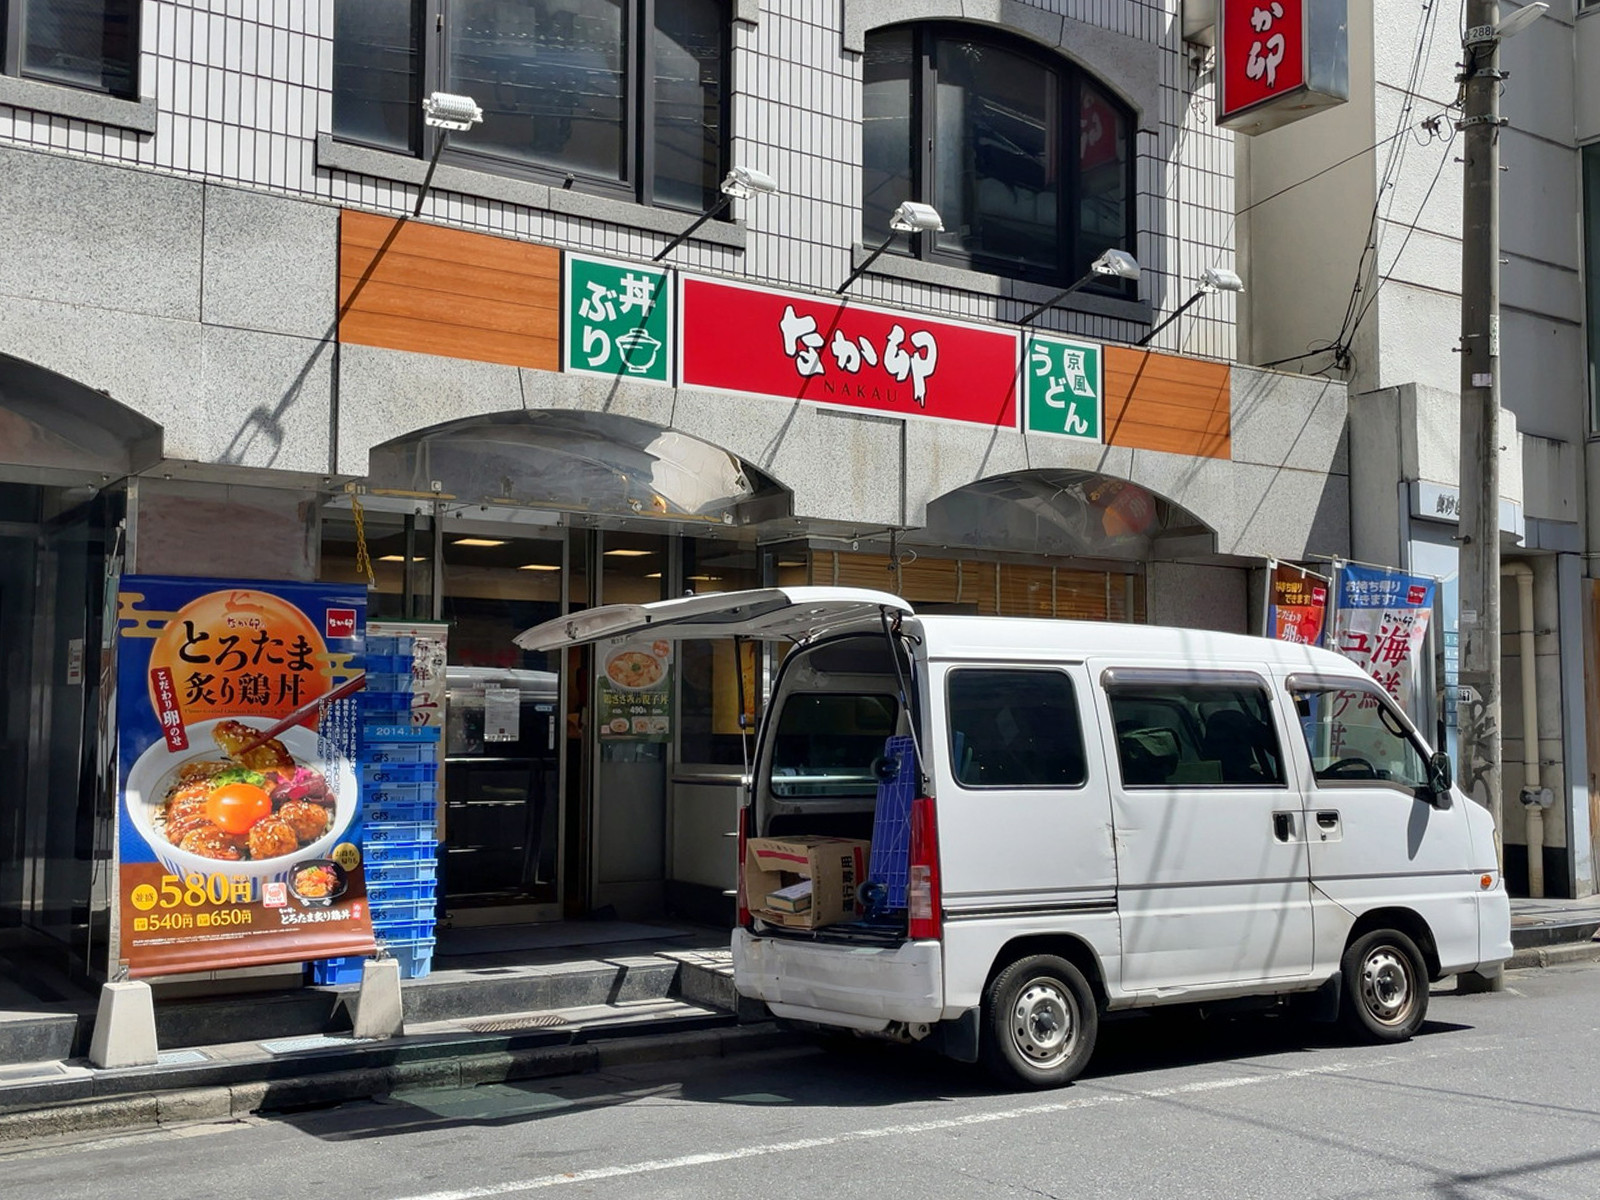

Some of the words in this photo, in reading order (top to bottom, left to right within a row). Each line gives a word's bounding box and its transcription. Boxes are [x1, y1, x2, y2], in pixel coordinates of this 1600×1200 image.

[618, 272, 657, 318] 丼
[779, 304, 938, 408] なか卯
[1067, 353, 1087, 393] 京風
[823, 380, 898, 403] NAKAU
[1031, 343, 1089, 434] うどん
[1345, 580, 1401, 594] お持ち帰り
[329, 618, 354, 629] なか卯
[179, 619, 314, 672] とろたま
[183, 671, 306, 707] 炙り鶏丼
[157, 671, 182, 746] こだわり卵のせ
[373, 753, 389, 762] GFS
[373, 773, 390, 782] GFS
[371, 792, 389, 801] GFS
[371, 812, 389, 821] GFS
[371, 832, 389, 841] GFS
[371, 851, 389, 860] GFS
[370, 872, 388, 881] GFS
[160, 872, 252, 908] 580円
[370, 891, 387, 900] GFS
[149, 913, 194, 930] 540円
[211, 908, 253, 926] 650円
[371, 910, 387, 920] GFS
